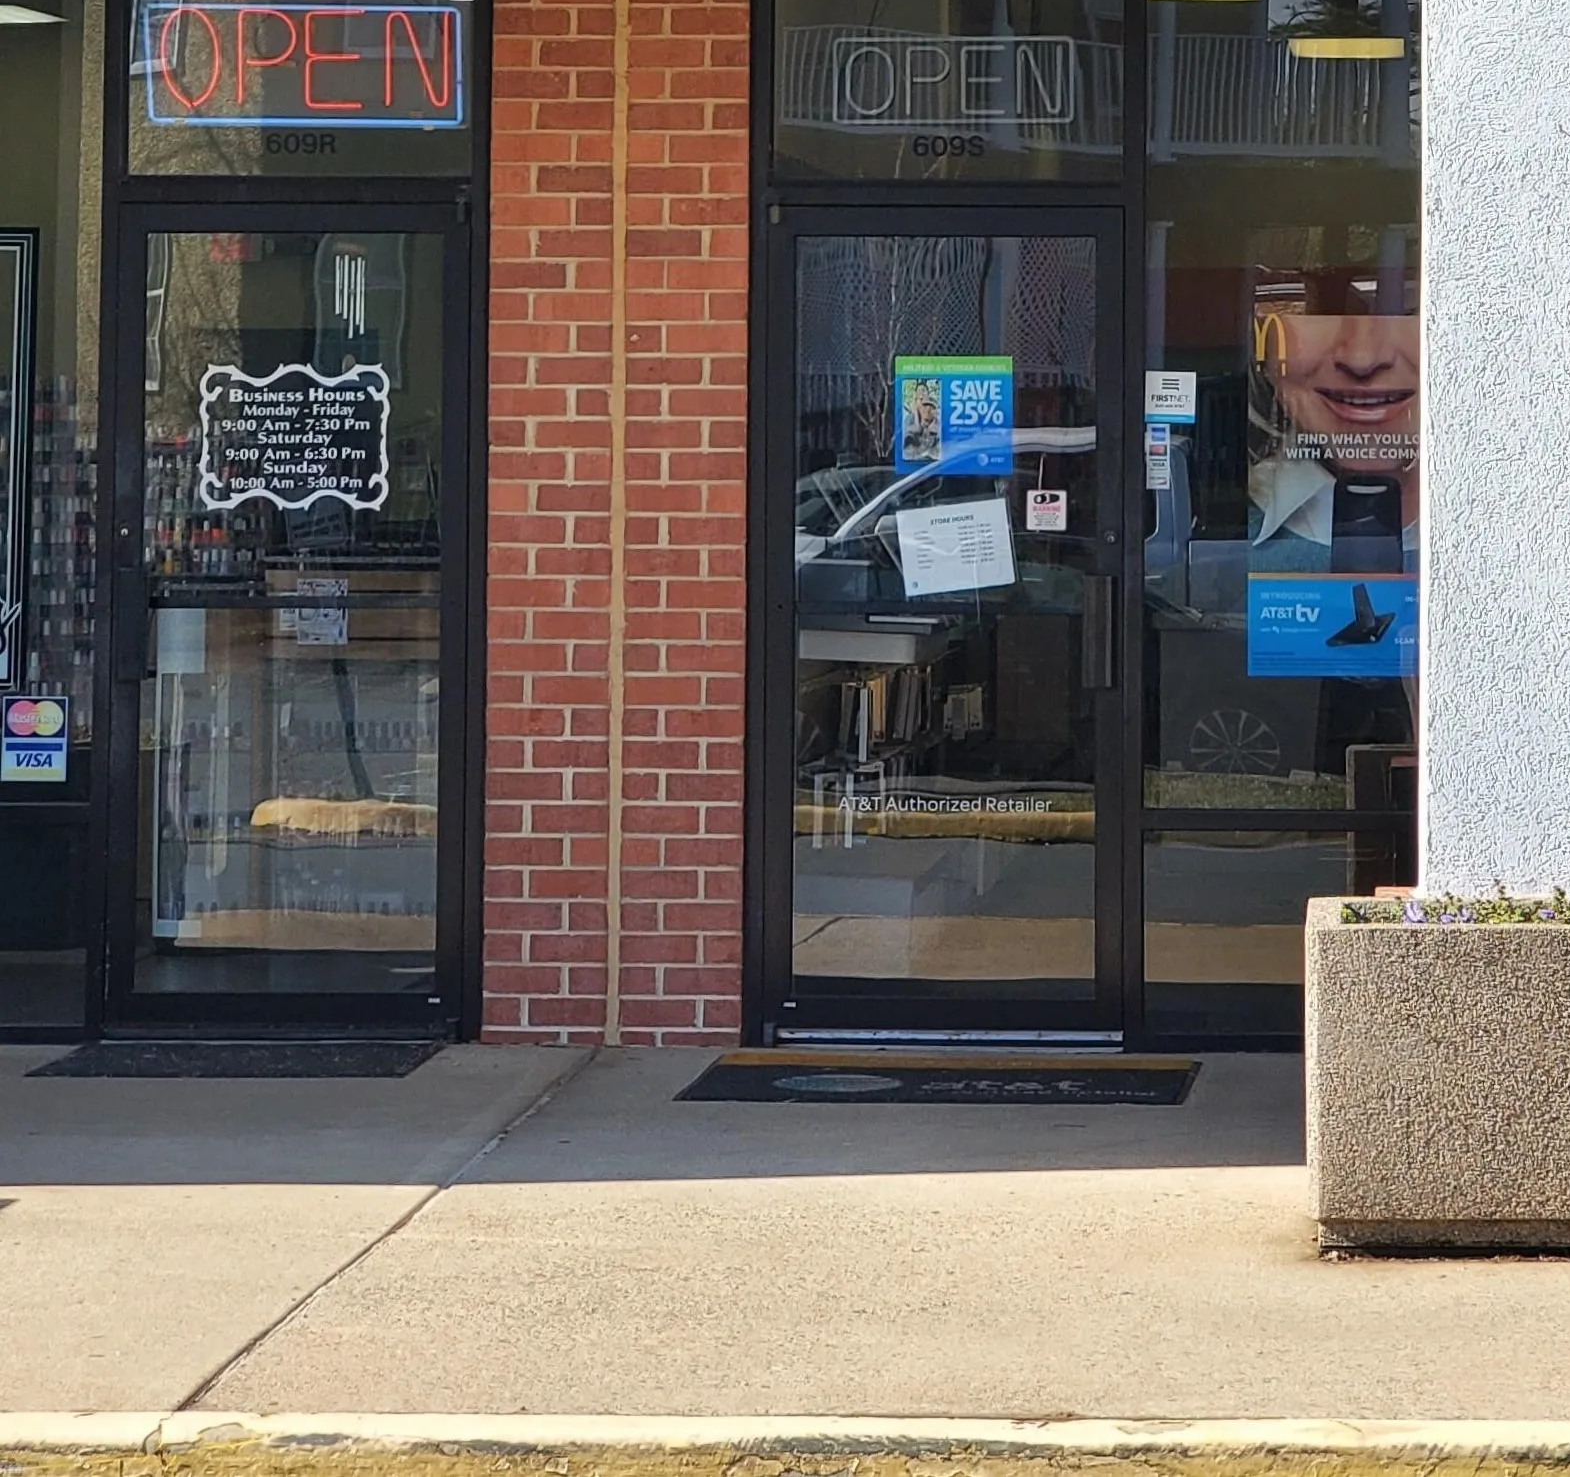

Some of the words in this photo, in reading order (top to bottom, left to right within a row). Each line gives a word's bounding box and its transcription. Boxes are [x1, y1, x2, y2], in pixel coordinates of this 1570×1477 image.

[159, 6, 452, 110] OPEN
[845, 44, 1063, 116] OPEN
[266, 133, 336, 154] 609R
[912, 135, 985, 157] 609S
[949, 379, 1003, 401] SAVE
[242, 403, 300, 417] Monday
[312, 403, 355, 418] Friday
[949, 400, 1004, 426] 25%
[221, 420, 257, 432] 9:00
[261, 420, 290, 431] Am
[304, 419, 340, 431] 7:30
[344, 419, 371, 431] Pm
[257, 431, 333, 446] Saturday
[1297, 433, 1328, 445] FIND
[1331, 433, 1371, 445] WHAT
[1373, 433, 1401, 445] YOU
[225, 449, 259, 461] 9:00
[263, 449, 291, 460] Am
[304, 448, 338, 460] 6:30
[342, 448, 366, 460] Pm
[1286, 448, 1321, 459] WITH
[1323, 448, 1333, 459] A
[1336, 448, 1377, 459] VOICE
[263, 461, 328, 475] Sunday
[230, 478, 266, 489] 10:00
[269, 478, 294, 489] Am
[307, 477, 339, 489] 5:00
[341, 477, 363, 488] Pm
[930, 517, 950, 526] STORE
[1260, 592, 1321, 600] INTRODUCING
[1260, 606, 1294, 619] AT&T
[1295, 603, 1321, 623] tv
[15, 753, 53, 768] VISA
[838, 796, 882, 812] AT&T
[885, 796, 982, 812] Authorized
[985, 796, 1053, 813] Retailer
